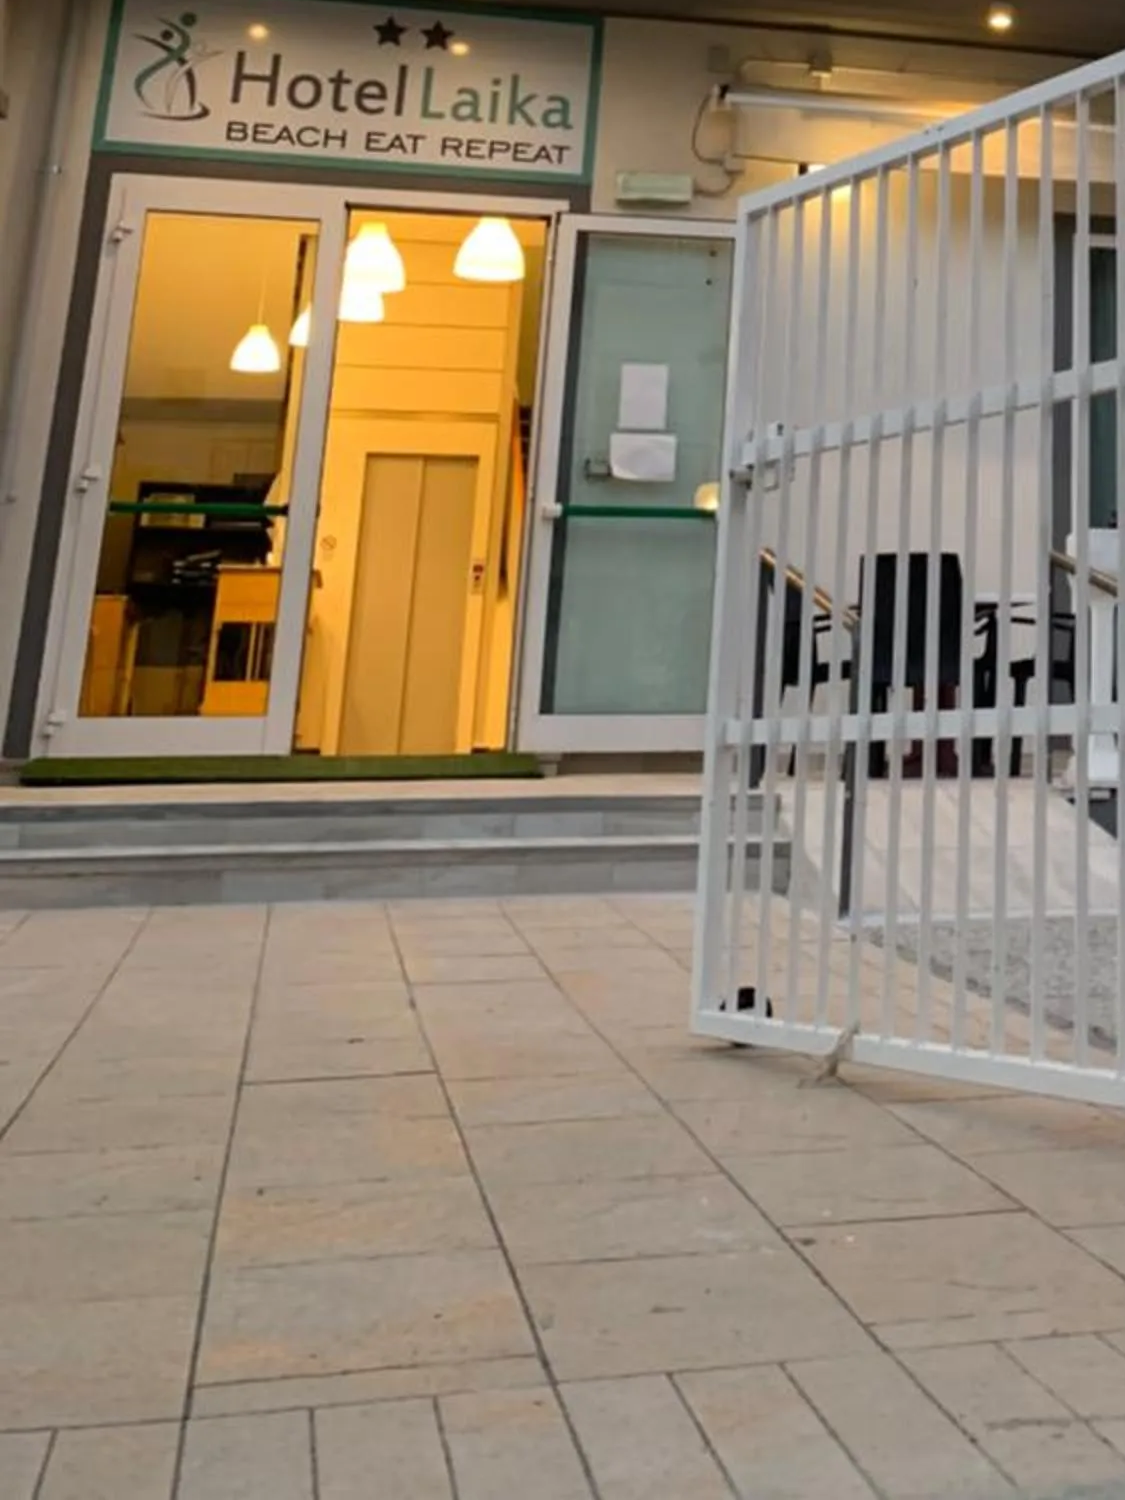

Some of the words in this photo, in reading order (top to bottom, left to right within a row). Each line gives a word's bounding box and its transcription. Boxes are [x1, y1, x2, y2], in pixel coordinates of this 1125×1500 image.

[229, 50, 408, 117] Hotel
[420, 66, 574, 131] Laika
[225, 121, 347, 149] BEACH
[365, 131, 427, 156] EAT
[440, 137, 572, 165] REPEAT
